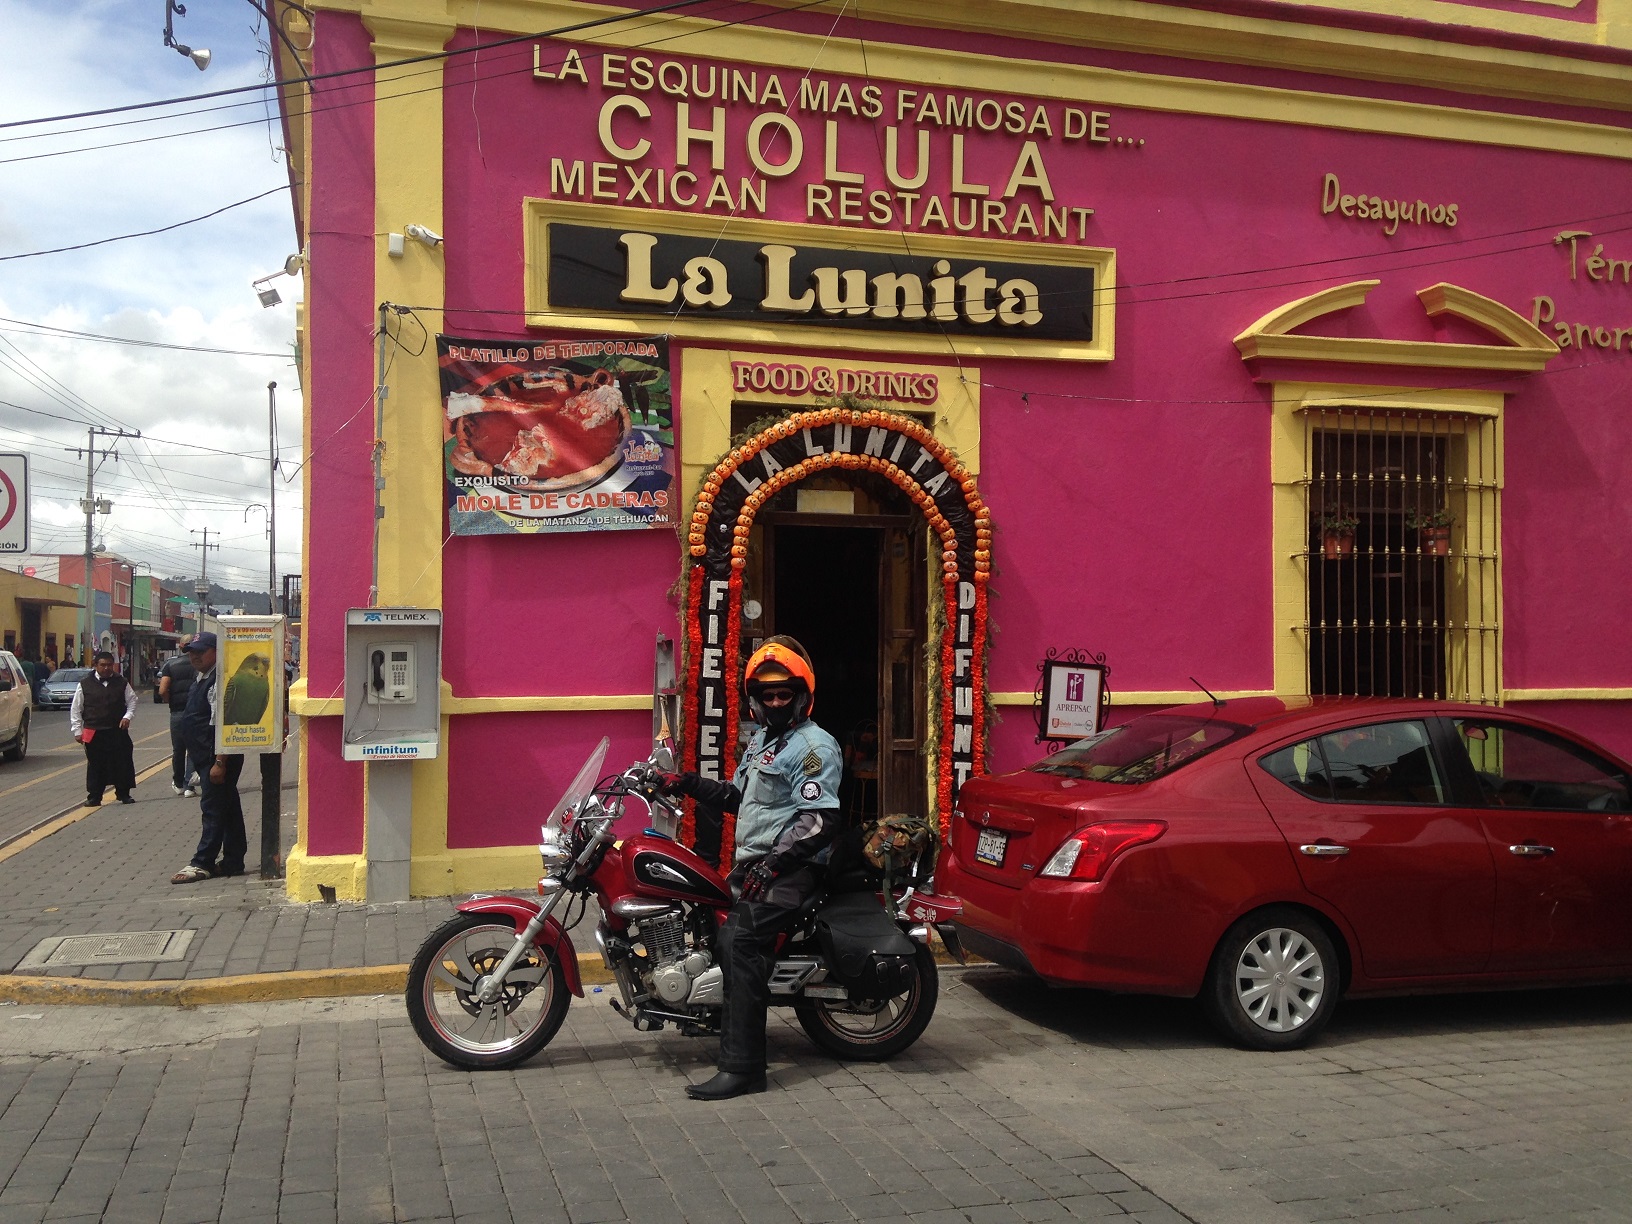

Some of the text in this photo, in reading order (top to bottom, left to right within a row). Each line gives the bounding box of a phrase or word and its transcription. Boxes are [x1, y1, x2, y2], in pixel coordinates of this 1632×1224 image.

[533, 44, 588, 83] LA
[602, 53, 788, 107] ESQUINA
[800, 78, 883, 118] MAS
[897, 89, 1053, 137] FAMOSA
[598, 94, 1055, 202] CHOLULA
[551, 158, 1095, 240] MEXICAN RESTAURANT
[1321, 172, 1459, 236] Desayunos
[616, 232, 1043, 327] La Lunita
[449, 341, 658, 362] PLATILLO DE TEMPORADA
[735, 364, 937, 400] FOOD & DRINKS
[732, 423, 951, 496] LA LUNITA
[454, 475, 529, 487] EXQUISITO
[456, 490, 669, 512] MOLE DE CADERAS
[509, 514, 669, 527] DE LA MATANZA DE TEHUACAN
[384, 613, 427, 621] TELMEX
[1056, 703, 1091, 713] APREPSAC
[249, 726, 265, 734] hasta
[362, 745, 417, 754] infinitum
